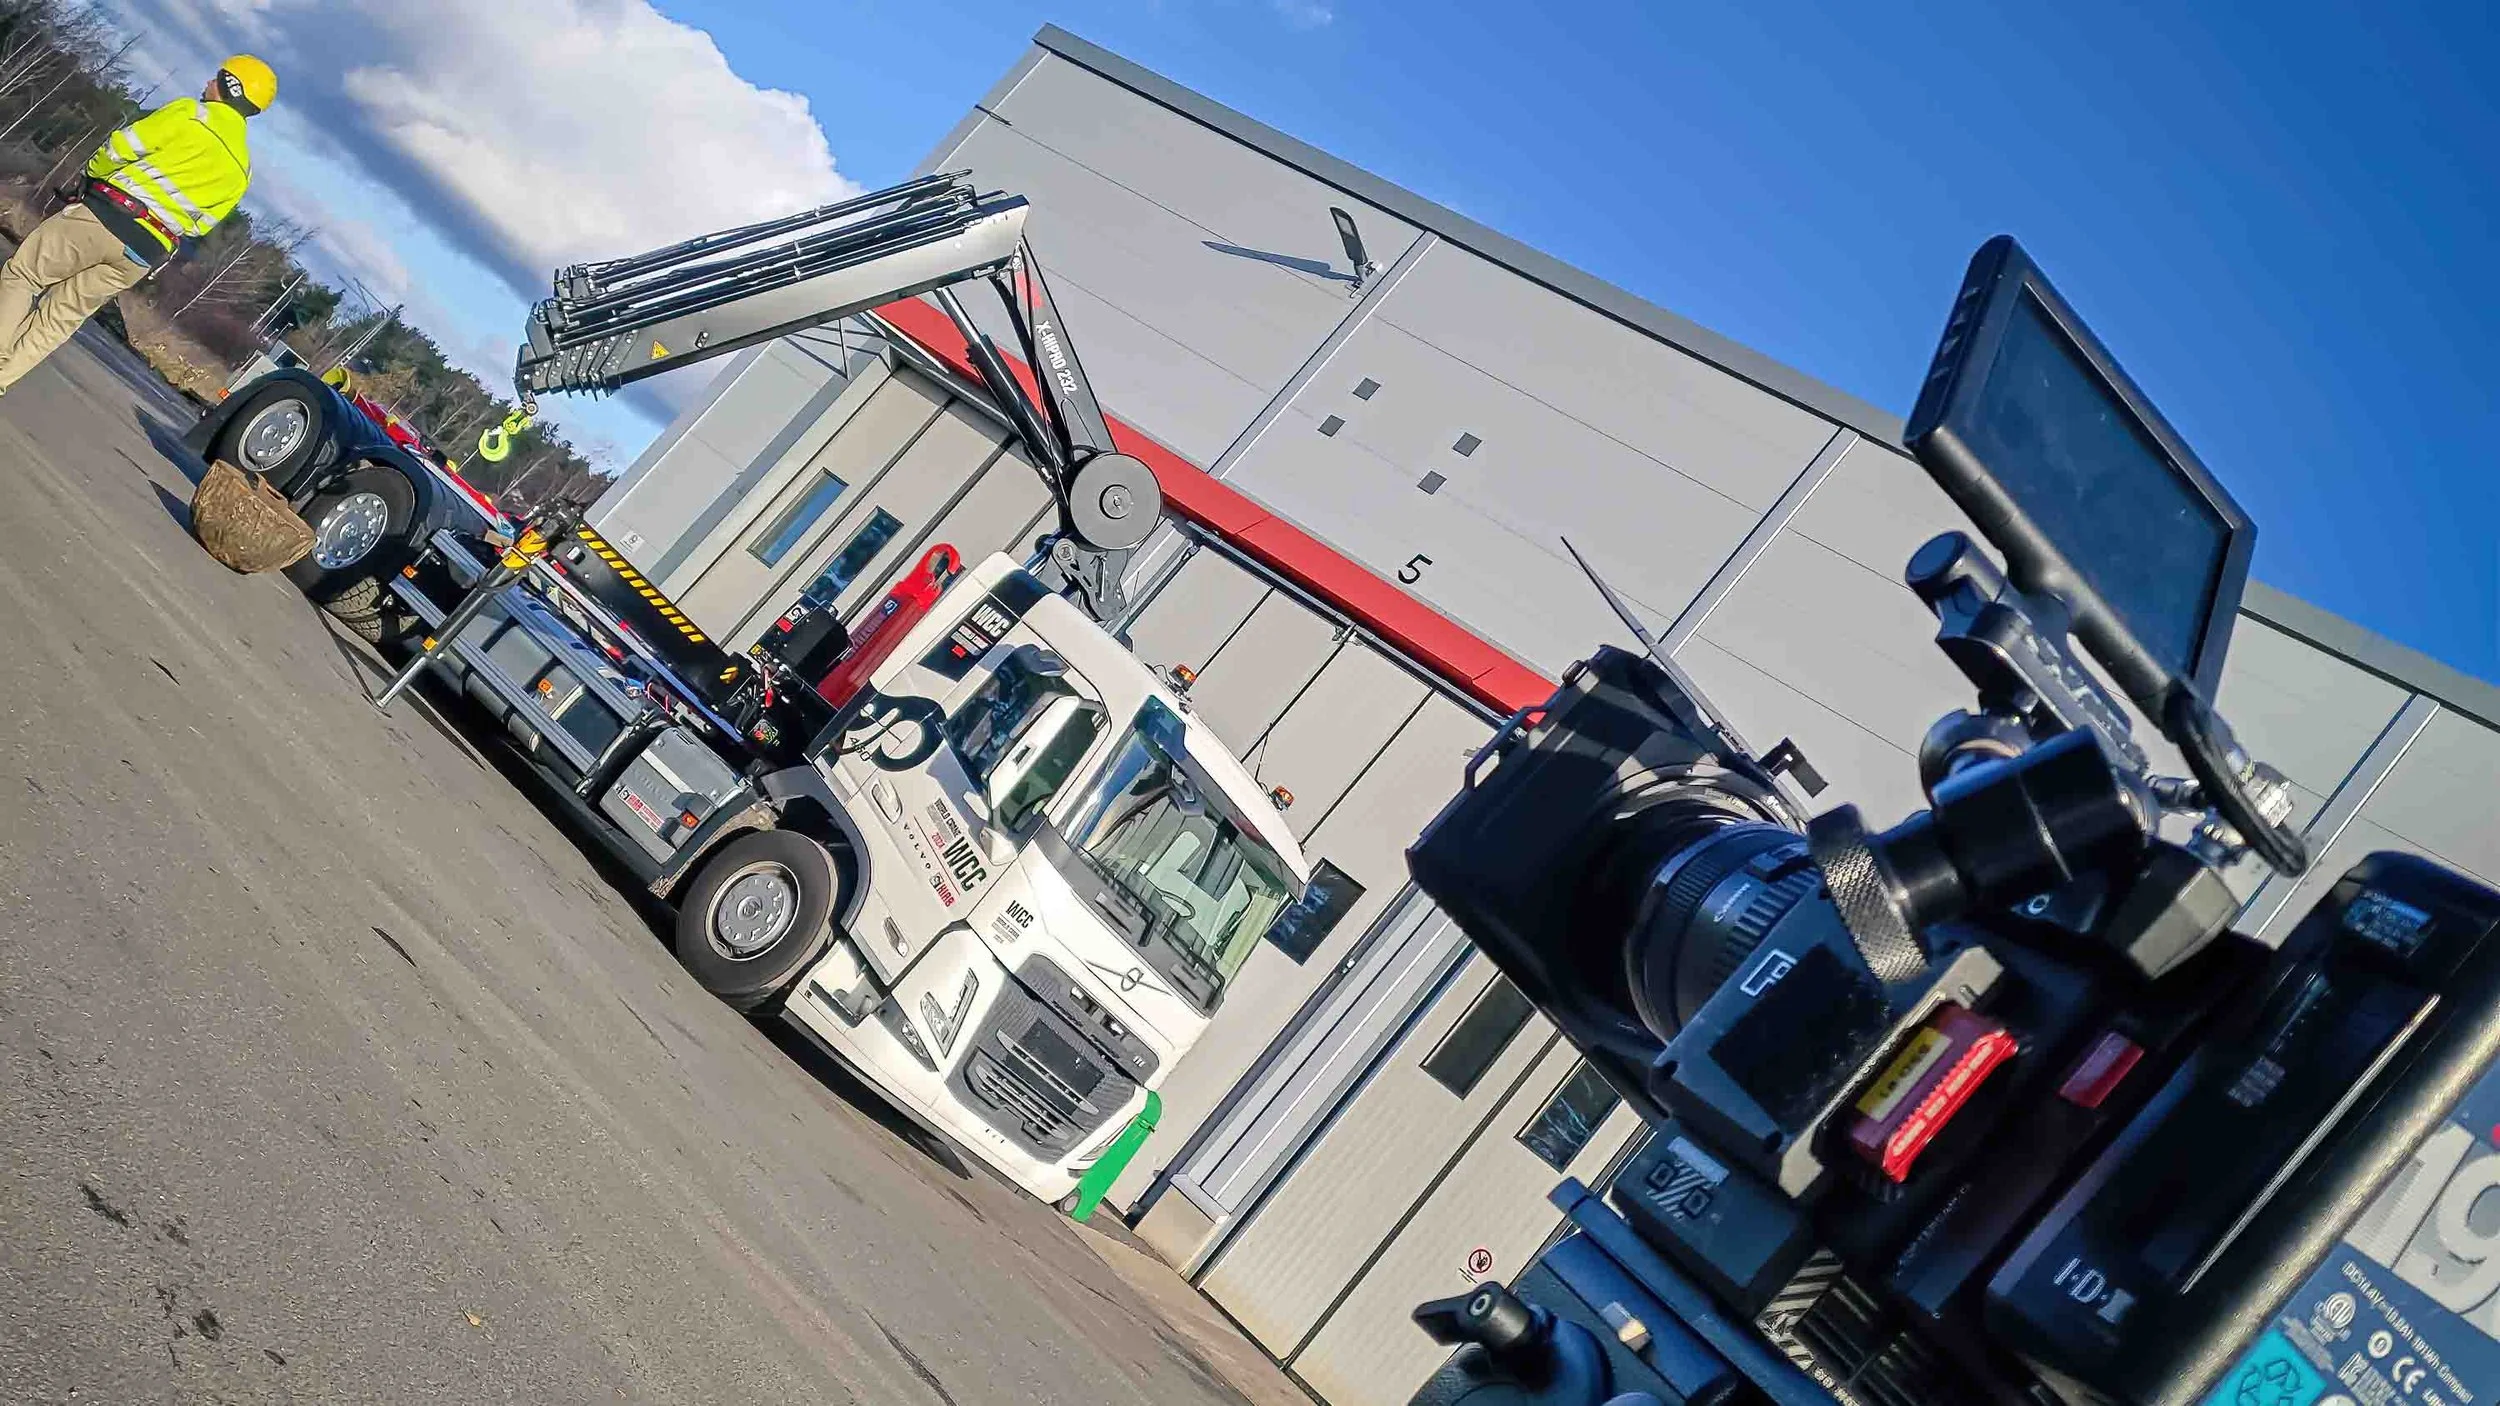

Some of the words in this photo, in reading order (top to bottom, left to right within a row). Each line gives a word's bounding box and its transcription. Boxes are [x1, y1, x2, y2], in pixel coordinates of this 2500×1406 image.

[1035, 320, 1066, 369] X-HIPRO
[1056, 368, 1077, 396] 232
[1397, 553, 1433, 585] 5
[970, 602, 1010, 638] WCC
[902, 823, 932, 869] VOLVO
[941, 836, 988, 892] WCC
[935, 882, 956, 907] HIAB
[1004, 899, 1035, 929] WCC
